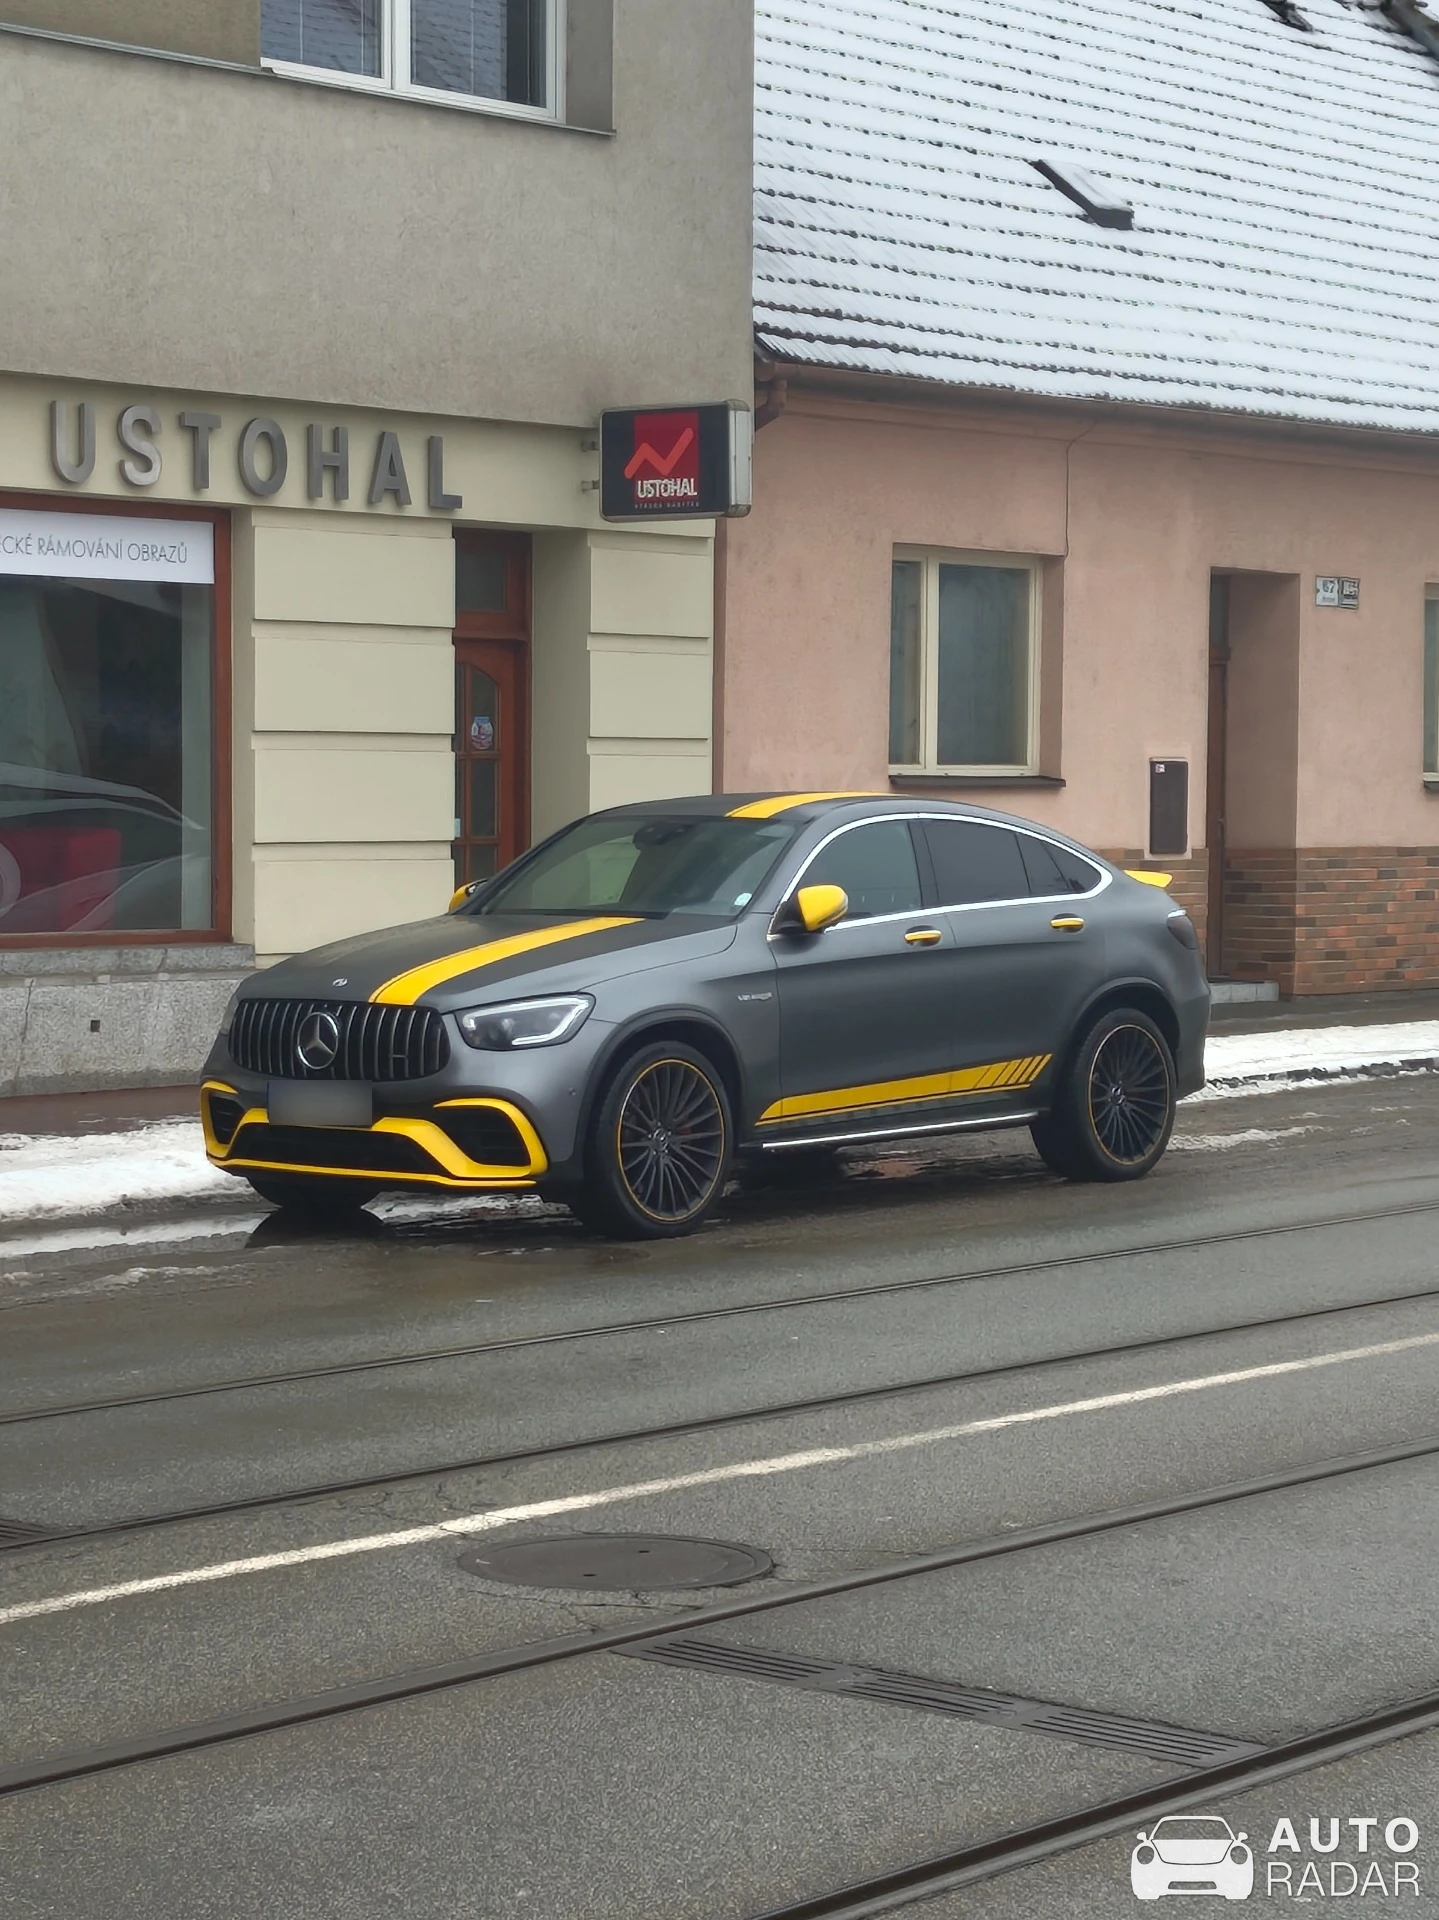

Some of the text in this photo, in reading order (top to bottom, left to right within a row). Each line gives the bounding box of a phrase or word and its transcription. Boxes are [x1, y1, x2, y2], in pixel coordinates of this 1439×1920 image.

[51, 400, 463, 509] USTOHAL
[637, 478, 698, 498] USTOHAL
[0, 533, 188, 564] CKÉ RÁMOVÁNÍ OBRAZŮ
